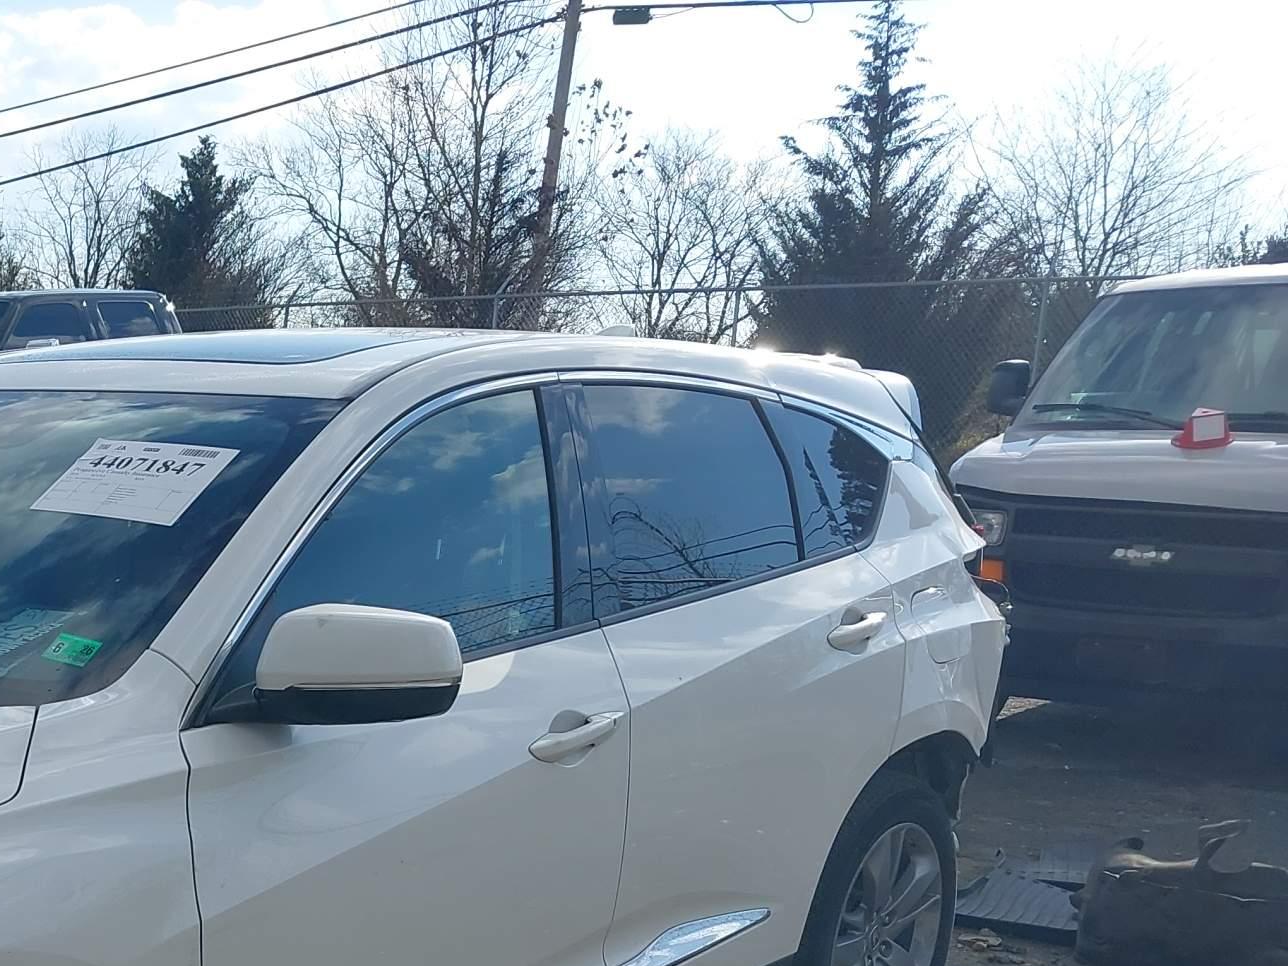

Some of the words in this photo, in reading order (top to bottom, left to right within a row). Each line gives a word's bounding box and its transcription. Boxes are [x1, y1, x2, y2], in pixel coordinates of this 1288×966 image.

[89, 455, 207, 476] 44071847
[52, 642, 65, 654] 6
[80, 644, 95, 656] 26
